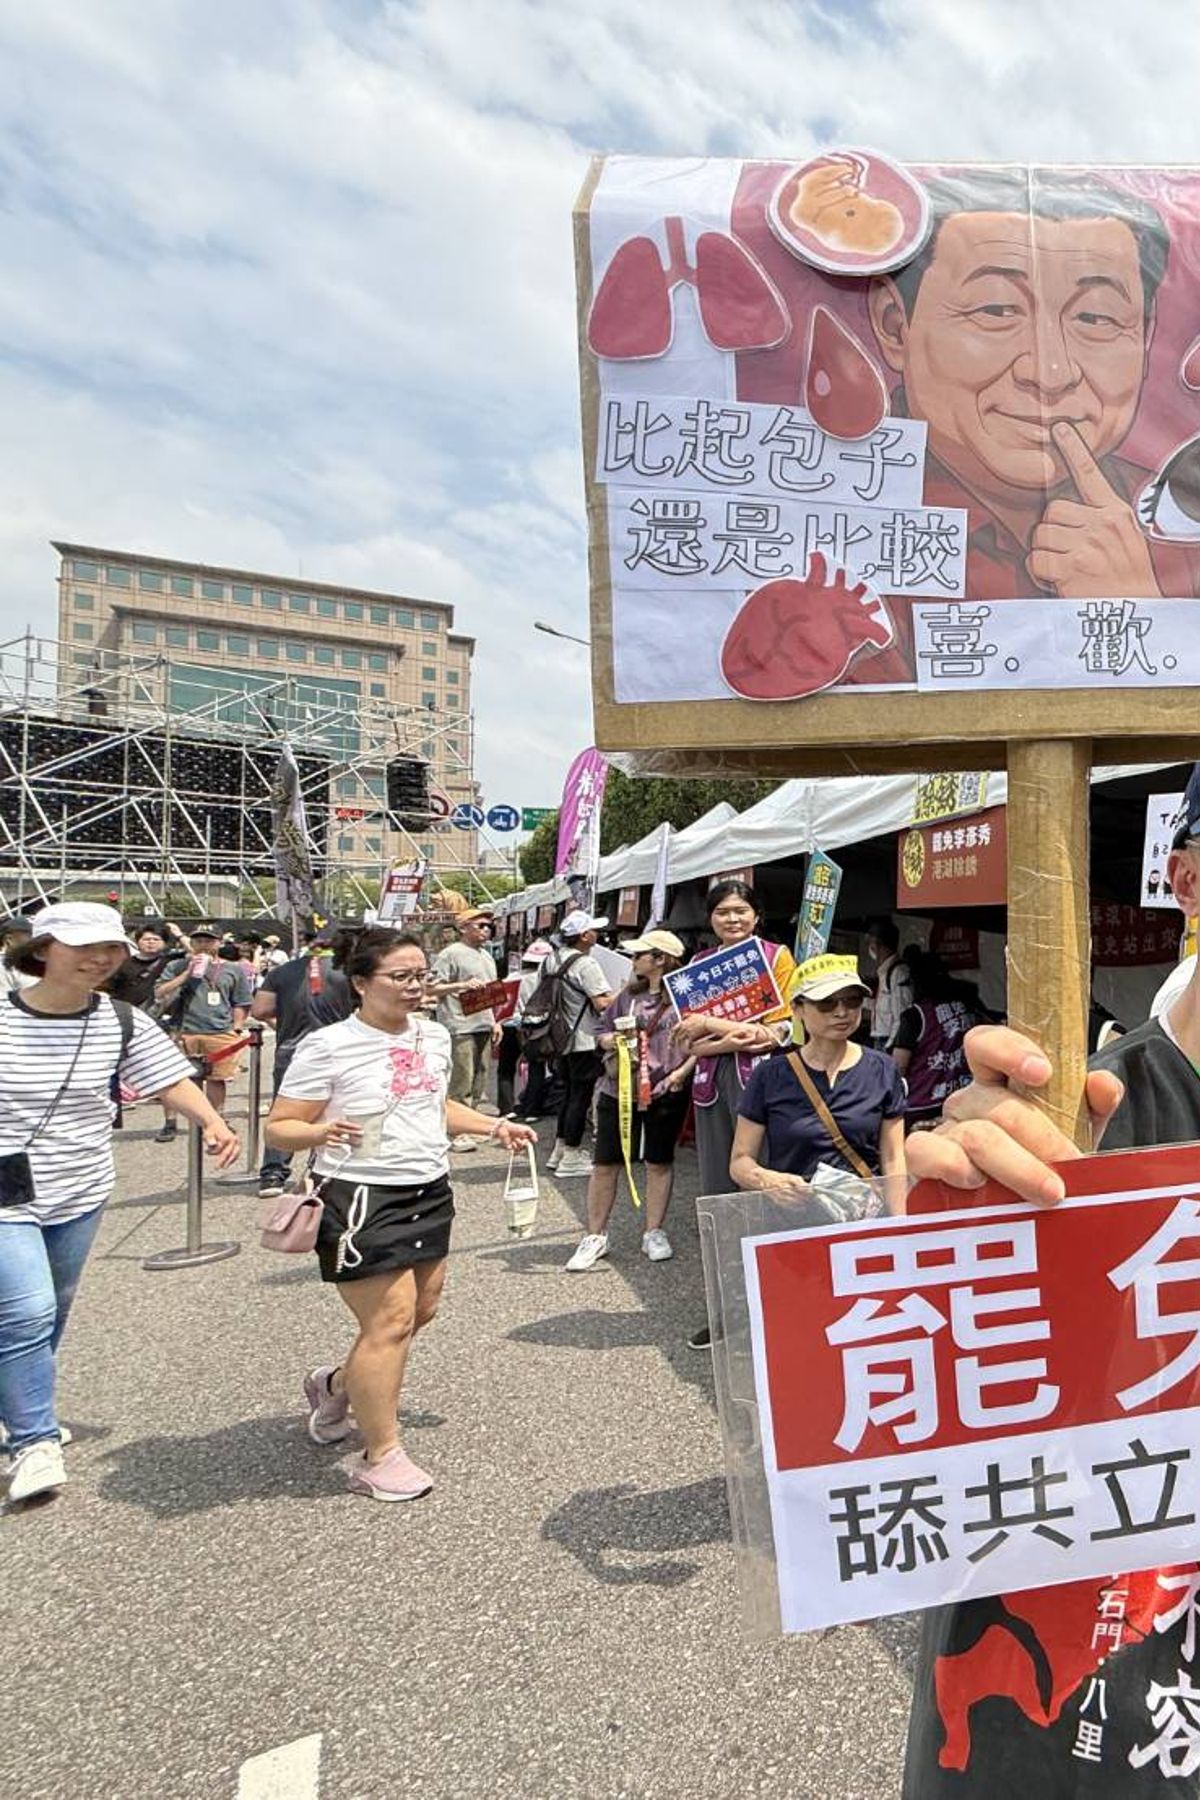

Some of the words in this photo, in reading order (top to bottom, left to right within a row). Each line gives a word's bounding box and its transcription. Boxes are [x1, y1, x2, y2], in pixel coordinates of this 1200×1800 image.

[604, 400, 917, 501] 比起包子
[624, 497, 960, 590] 還是比較
[697, 949, 761, 982] 今日不罷免
